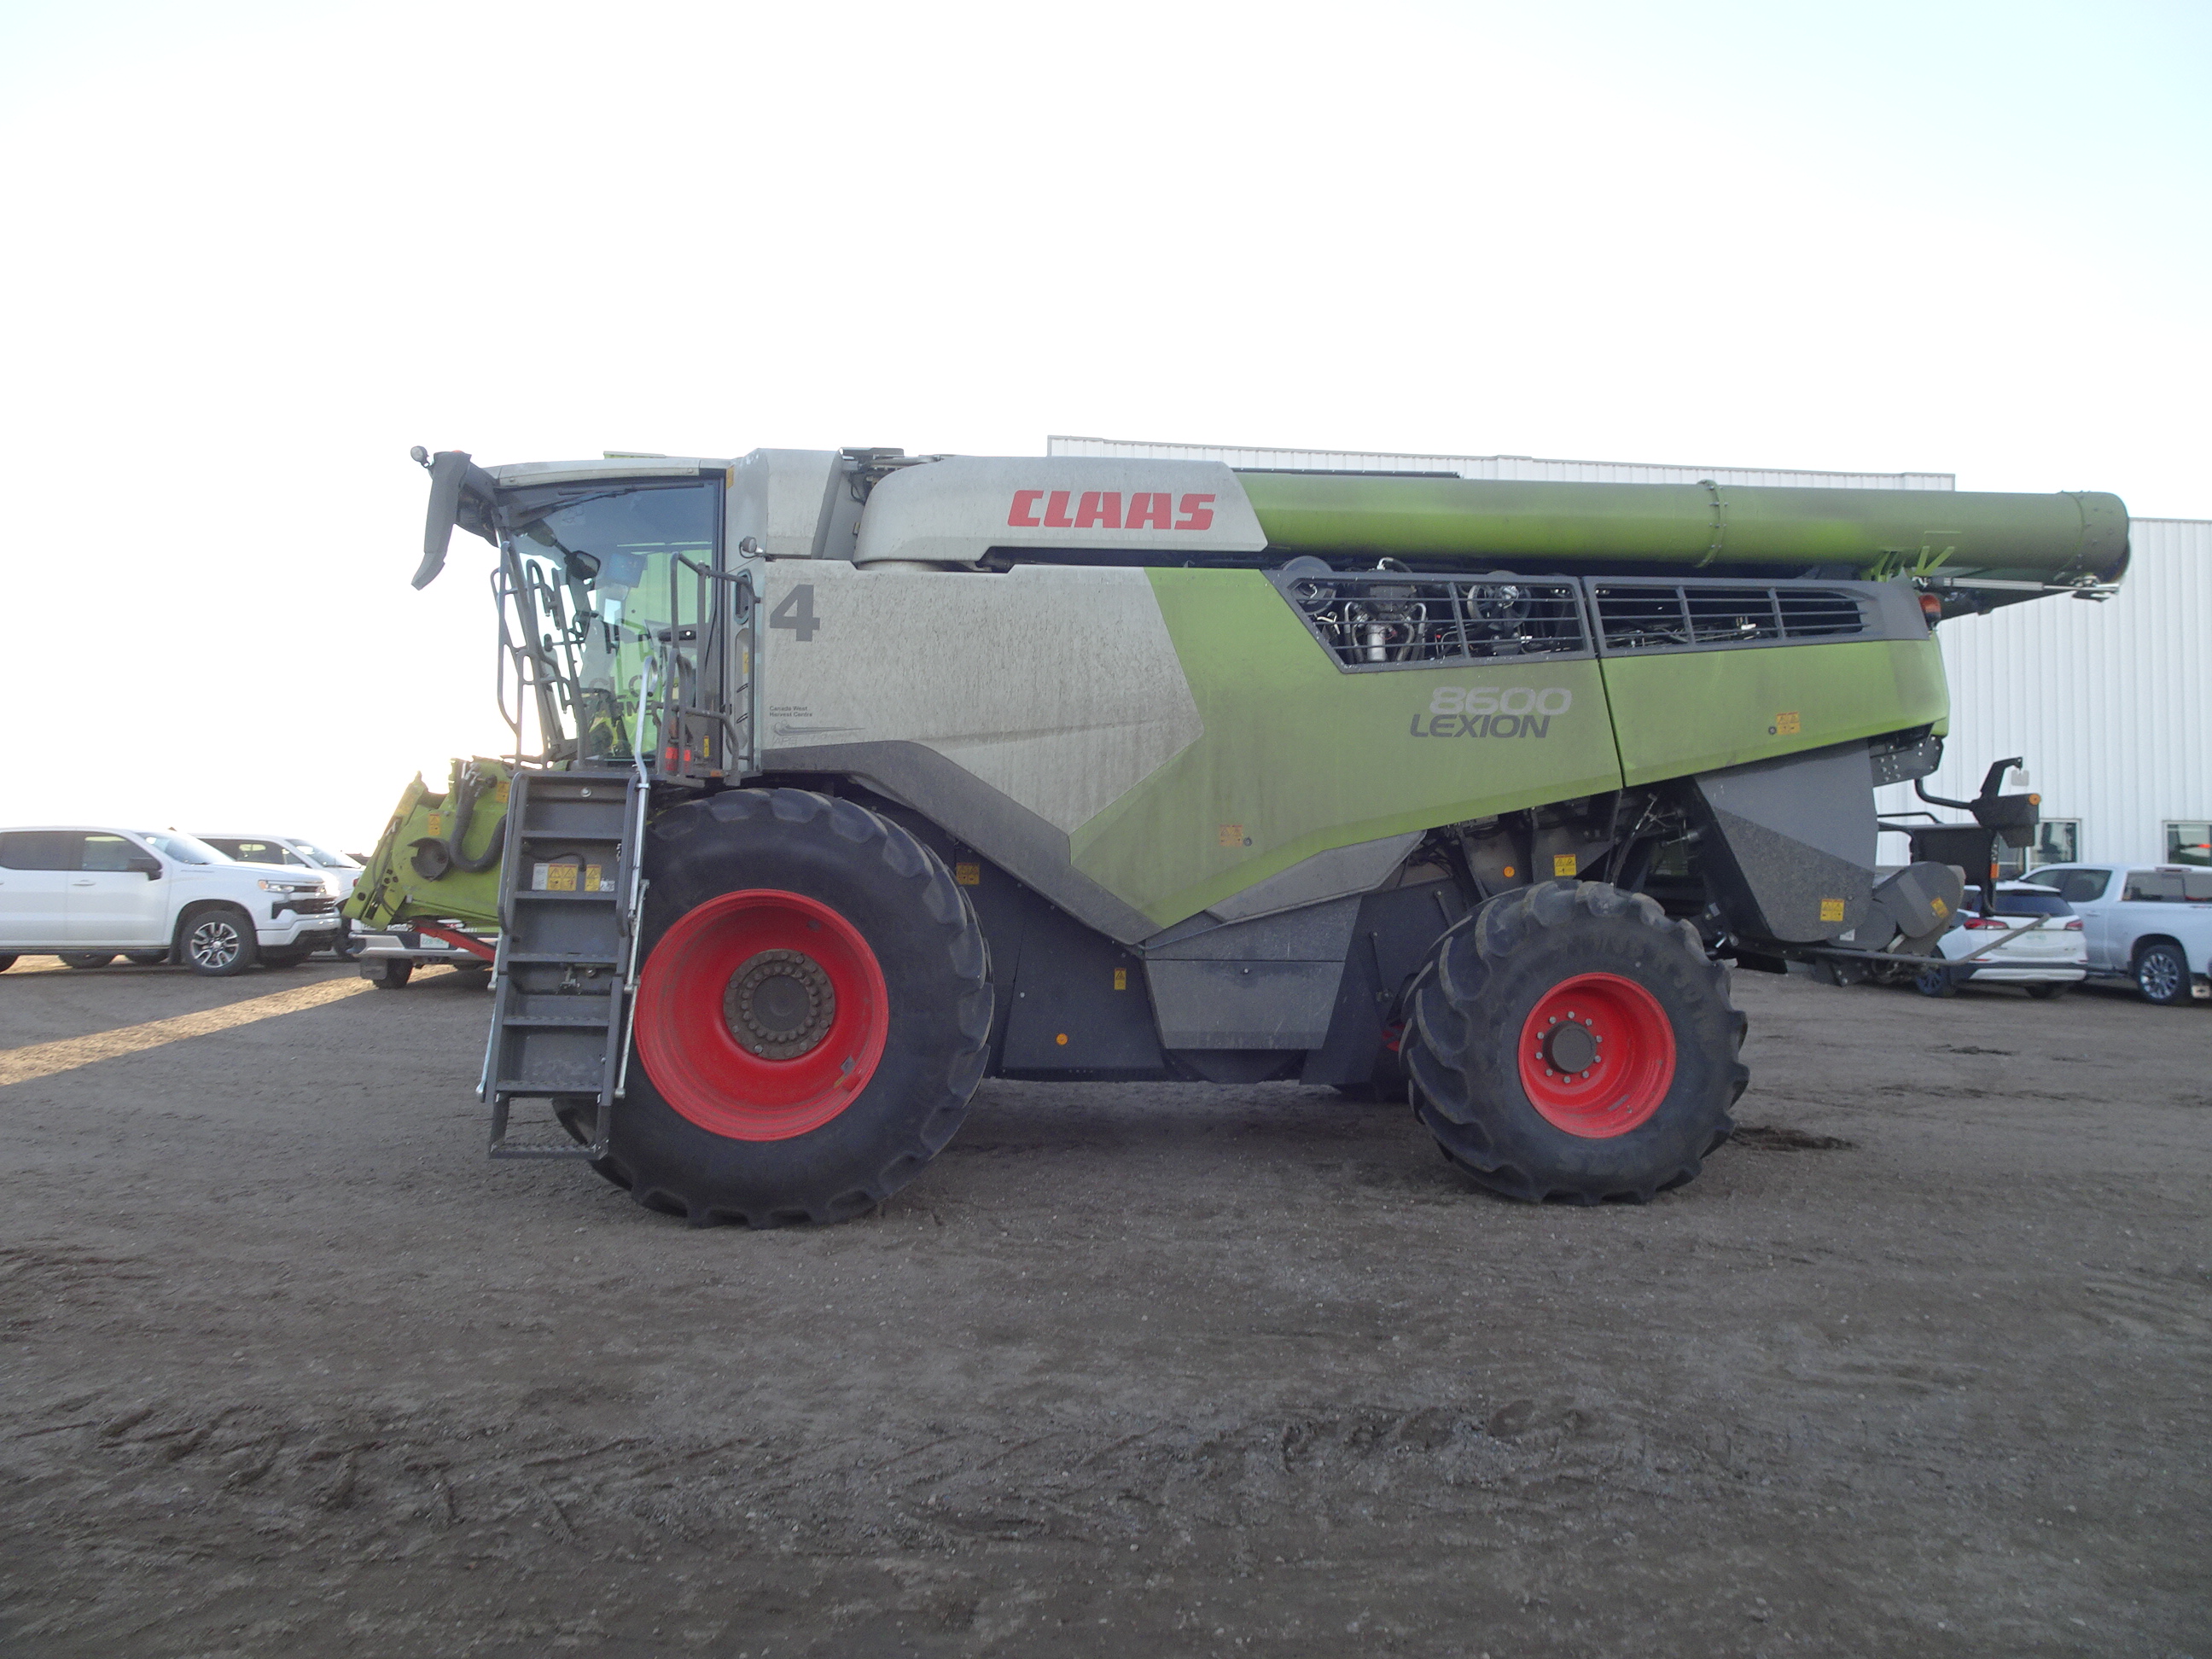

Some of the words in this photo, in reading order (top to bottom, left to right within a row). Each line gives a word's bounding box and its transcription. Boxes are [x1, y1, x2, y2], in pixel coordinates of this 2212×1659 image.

[1007, 490, 1217, 531] CLAAS
[770, 584, 821, 642] 4
[1429, 686, 1572, 715] 8600
[1410, 713, 1551, 738] LEXION
